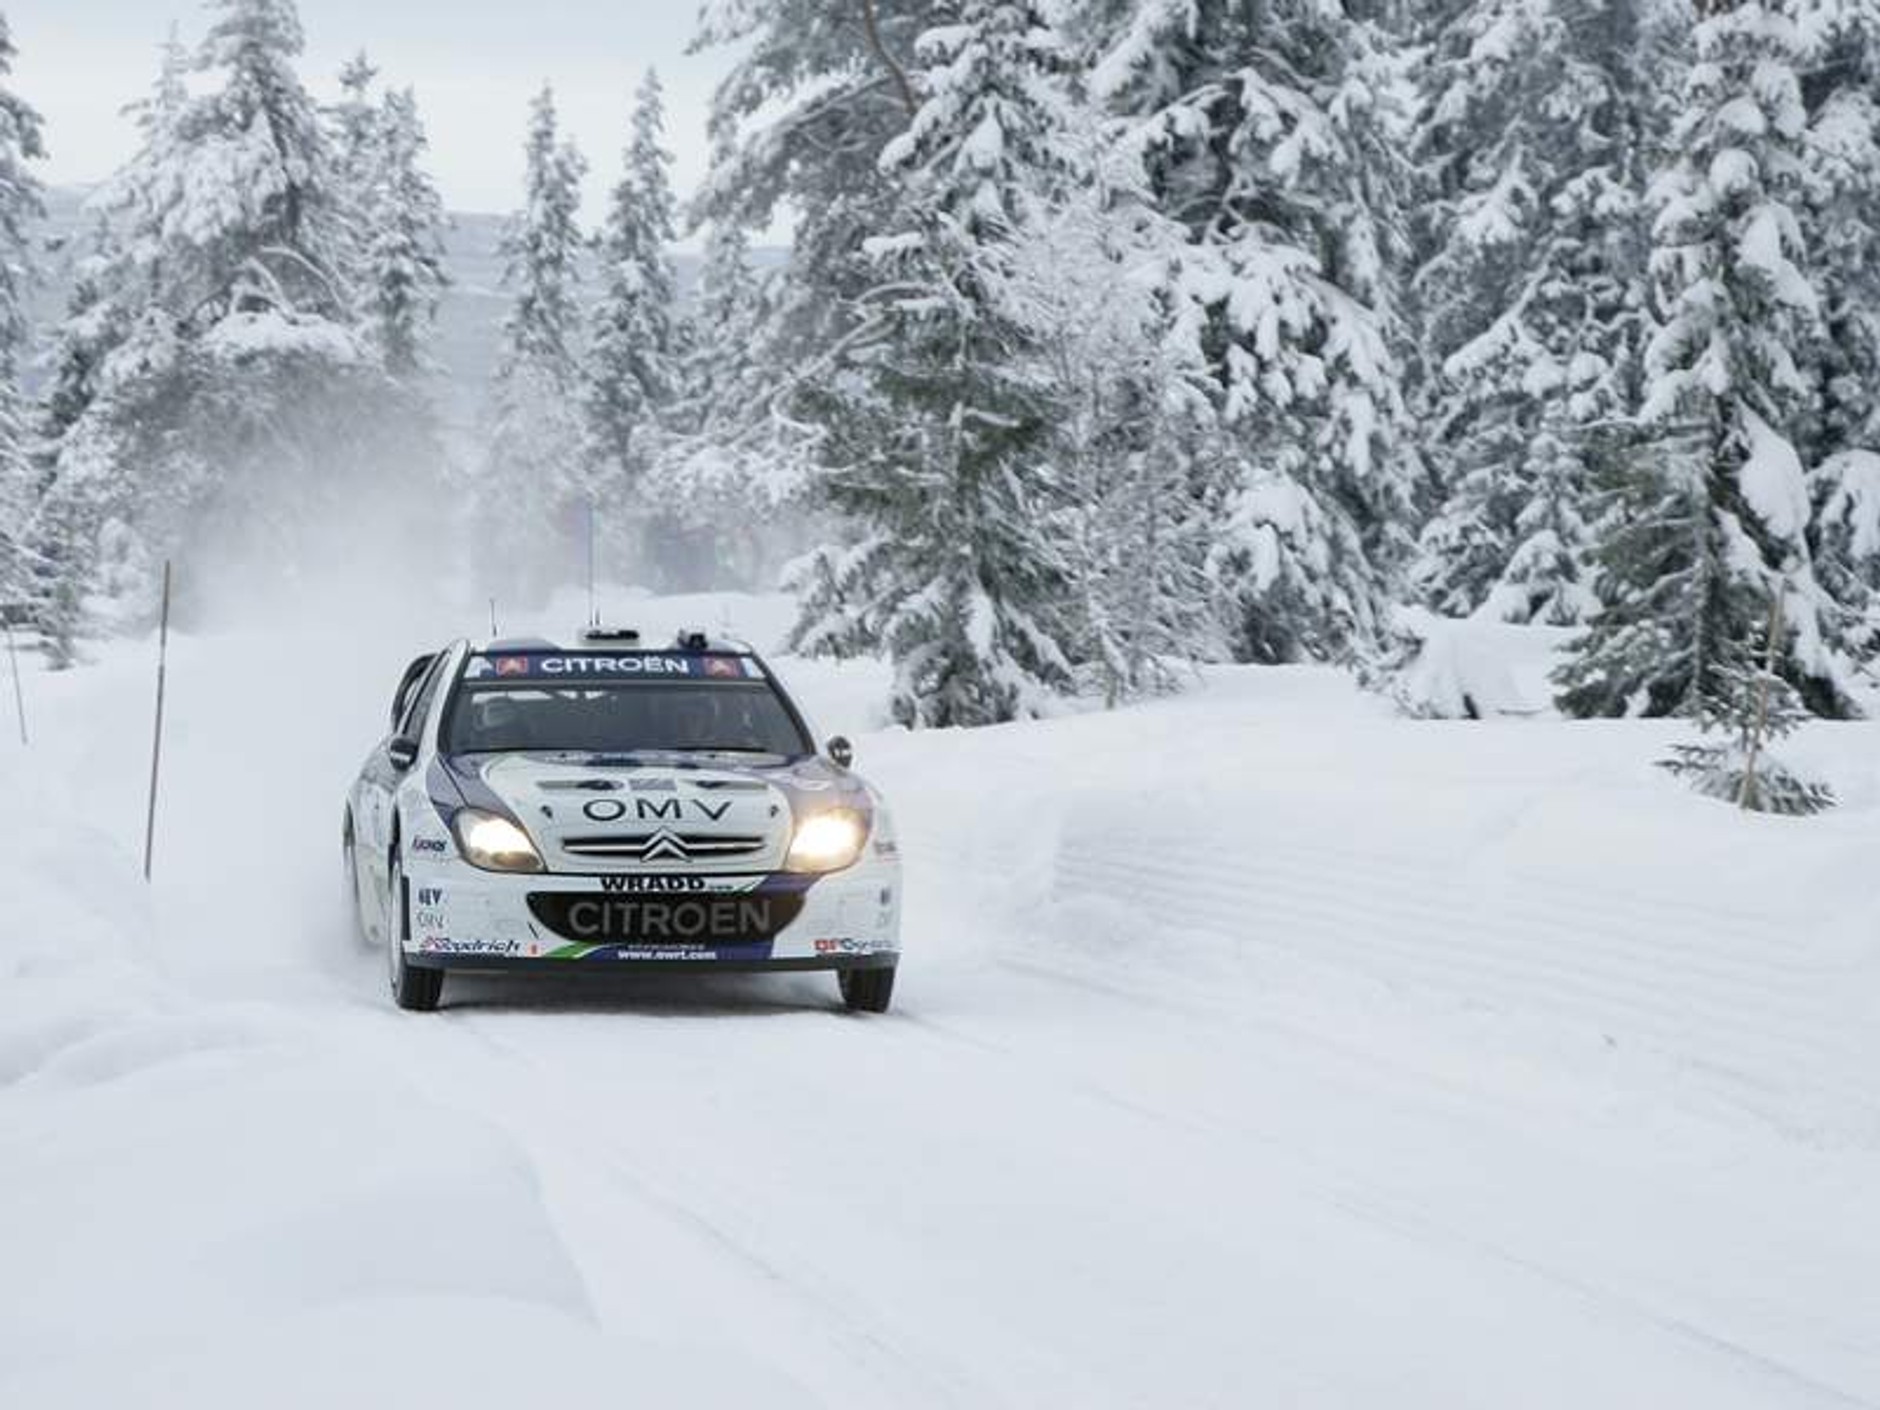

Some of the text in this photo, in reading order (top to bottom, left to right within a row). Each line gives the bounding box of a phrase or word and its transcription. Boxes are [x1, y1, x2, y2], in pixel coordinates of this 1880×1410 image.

[540, 656, 690, 674] CITROËN
[582, 798, 733, 822] OMV
[567, 901, 772, 936] CITROEN
